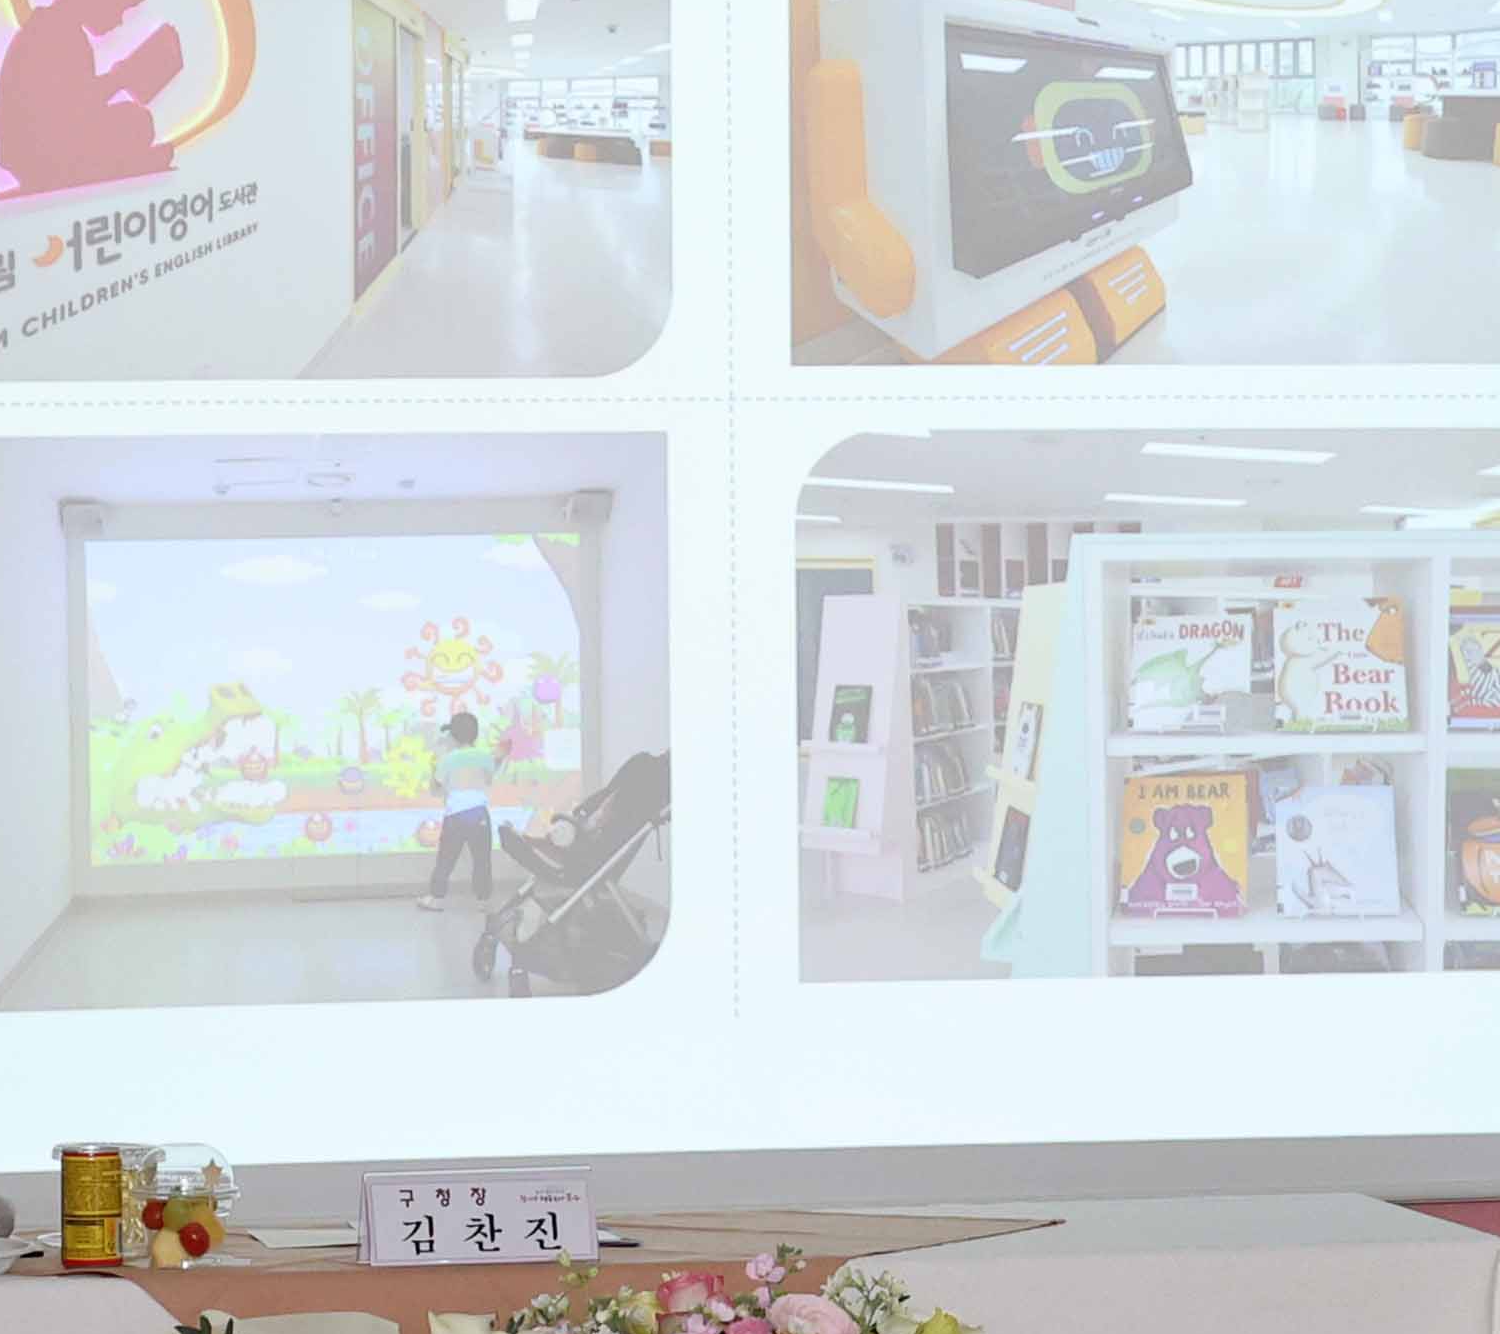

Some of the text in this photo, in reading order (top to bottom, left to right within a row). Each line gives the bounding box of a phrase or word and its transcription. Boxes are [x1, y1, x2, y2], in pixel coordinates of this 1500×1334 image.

[33, 186, 215, 272] 어린이영어
[217, 182, 260, 213] 도서관
[20, 270, 150, 339] CHILDREN'S
[153, 241, 214, 279] ENGLISH
[215, 221, 260, 252] LIBRARY
[1178, 619, 1245, 641] DRAGON
[1318, 621, 1365, 642] The
[1331, 663, 1396, 686] Bear
[1151, 784, 1180, 800] AM
[1186, 782, 1231, 799] BEAR
[399, 1187, 487, 1209] 구청장
[402, 1212, 563, 1256] 김찬진
